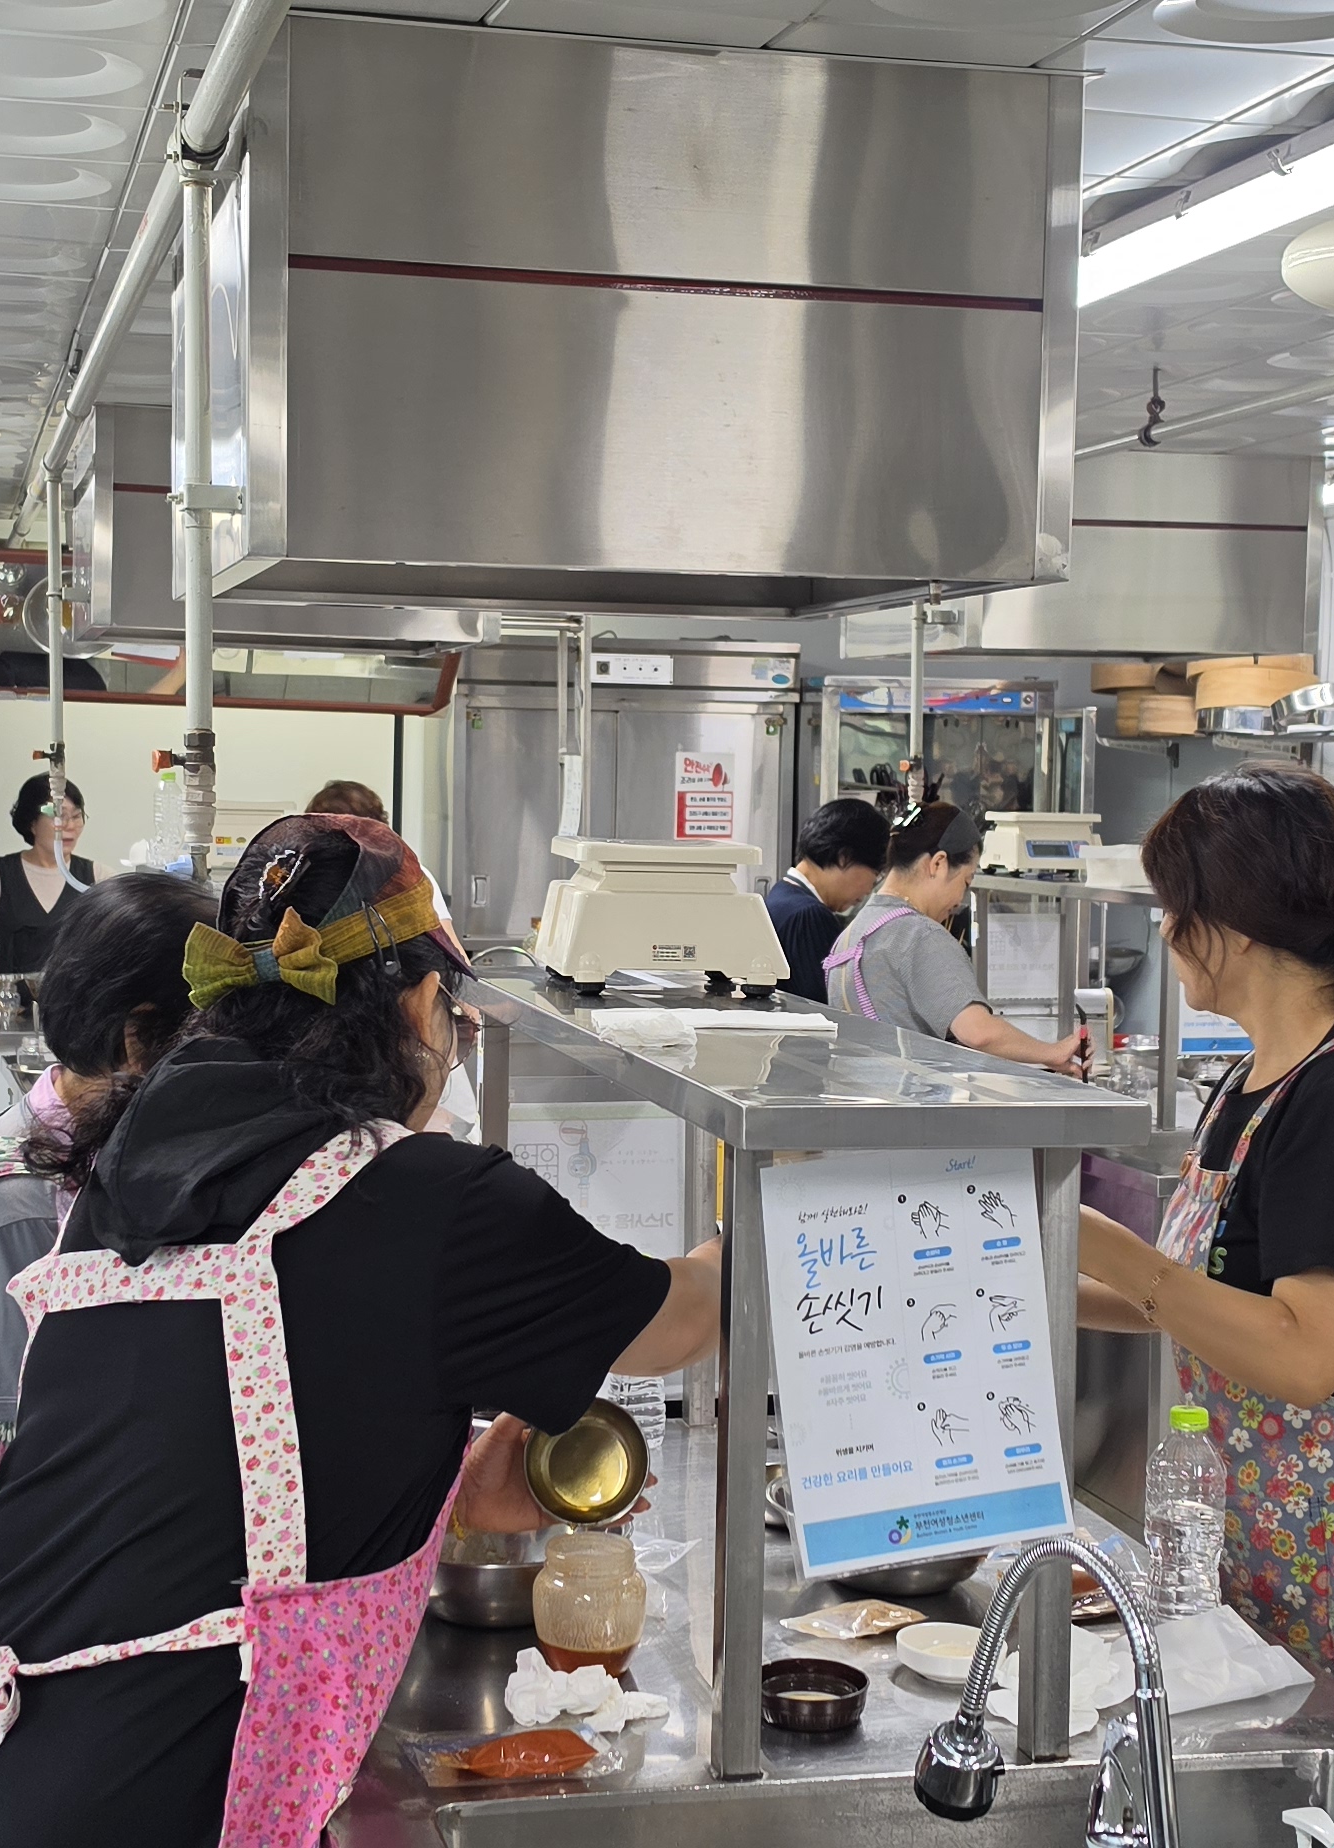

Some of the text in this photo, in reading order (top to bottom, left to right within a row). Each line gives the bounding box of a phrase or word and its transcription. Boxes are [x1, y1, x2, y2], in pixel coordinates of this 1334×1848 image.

[946, 1155, 976, 1173] Start!
[797, 1227, 878, 1290] 올바른
[796, 1285, 882, 1335] 손씻기
[818, 1345, 843, 1357] 손씻기가
[835, 1442, 875, 1457] 위생을 지키며
[802, 1472, 833, 1490] 건강한
[837, 1467, 868, 1484] 요리를
[871, 1460, 913, 1479] 만들어요
[915, 1510, 985, 1531] 부천여성청소년센터
